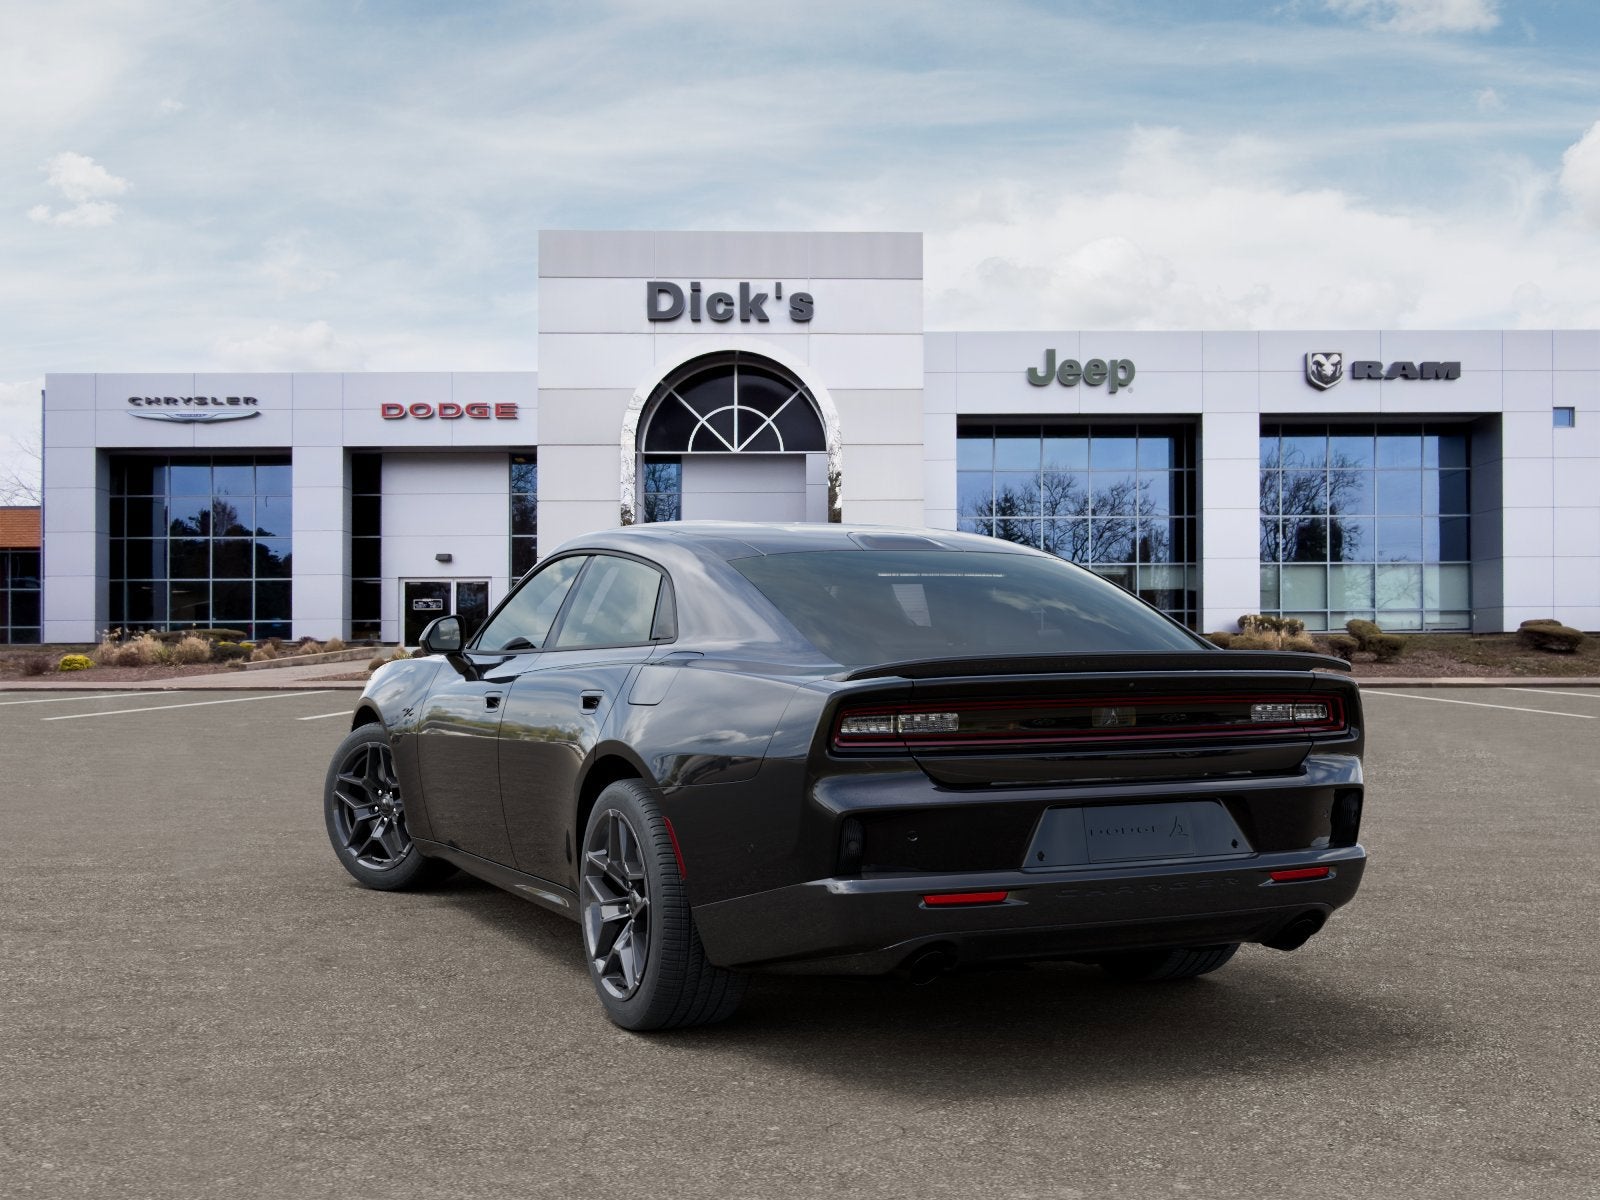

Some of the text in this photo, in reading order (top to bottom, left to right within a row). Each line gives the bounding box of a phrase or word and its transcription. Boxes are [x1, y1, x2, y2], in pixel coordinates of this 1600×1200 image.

[647, 281, 814, 322] Dick's
[1027, 348, 1136, 394] Jeep
[1352, 360, 1461, 381] RAM
[127, 396, 258, 407] CHRYSLER
[381, 402, 518, 420] DODGE
